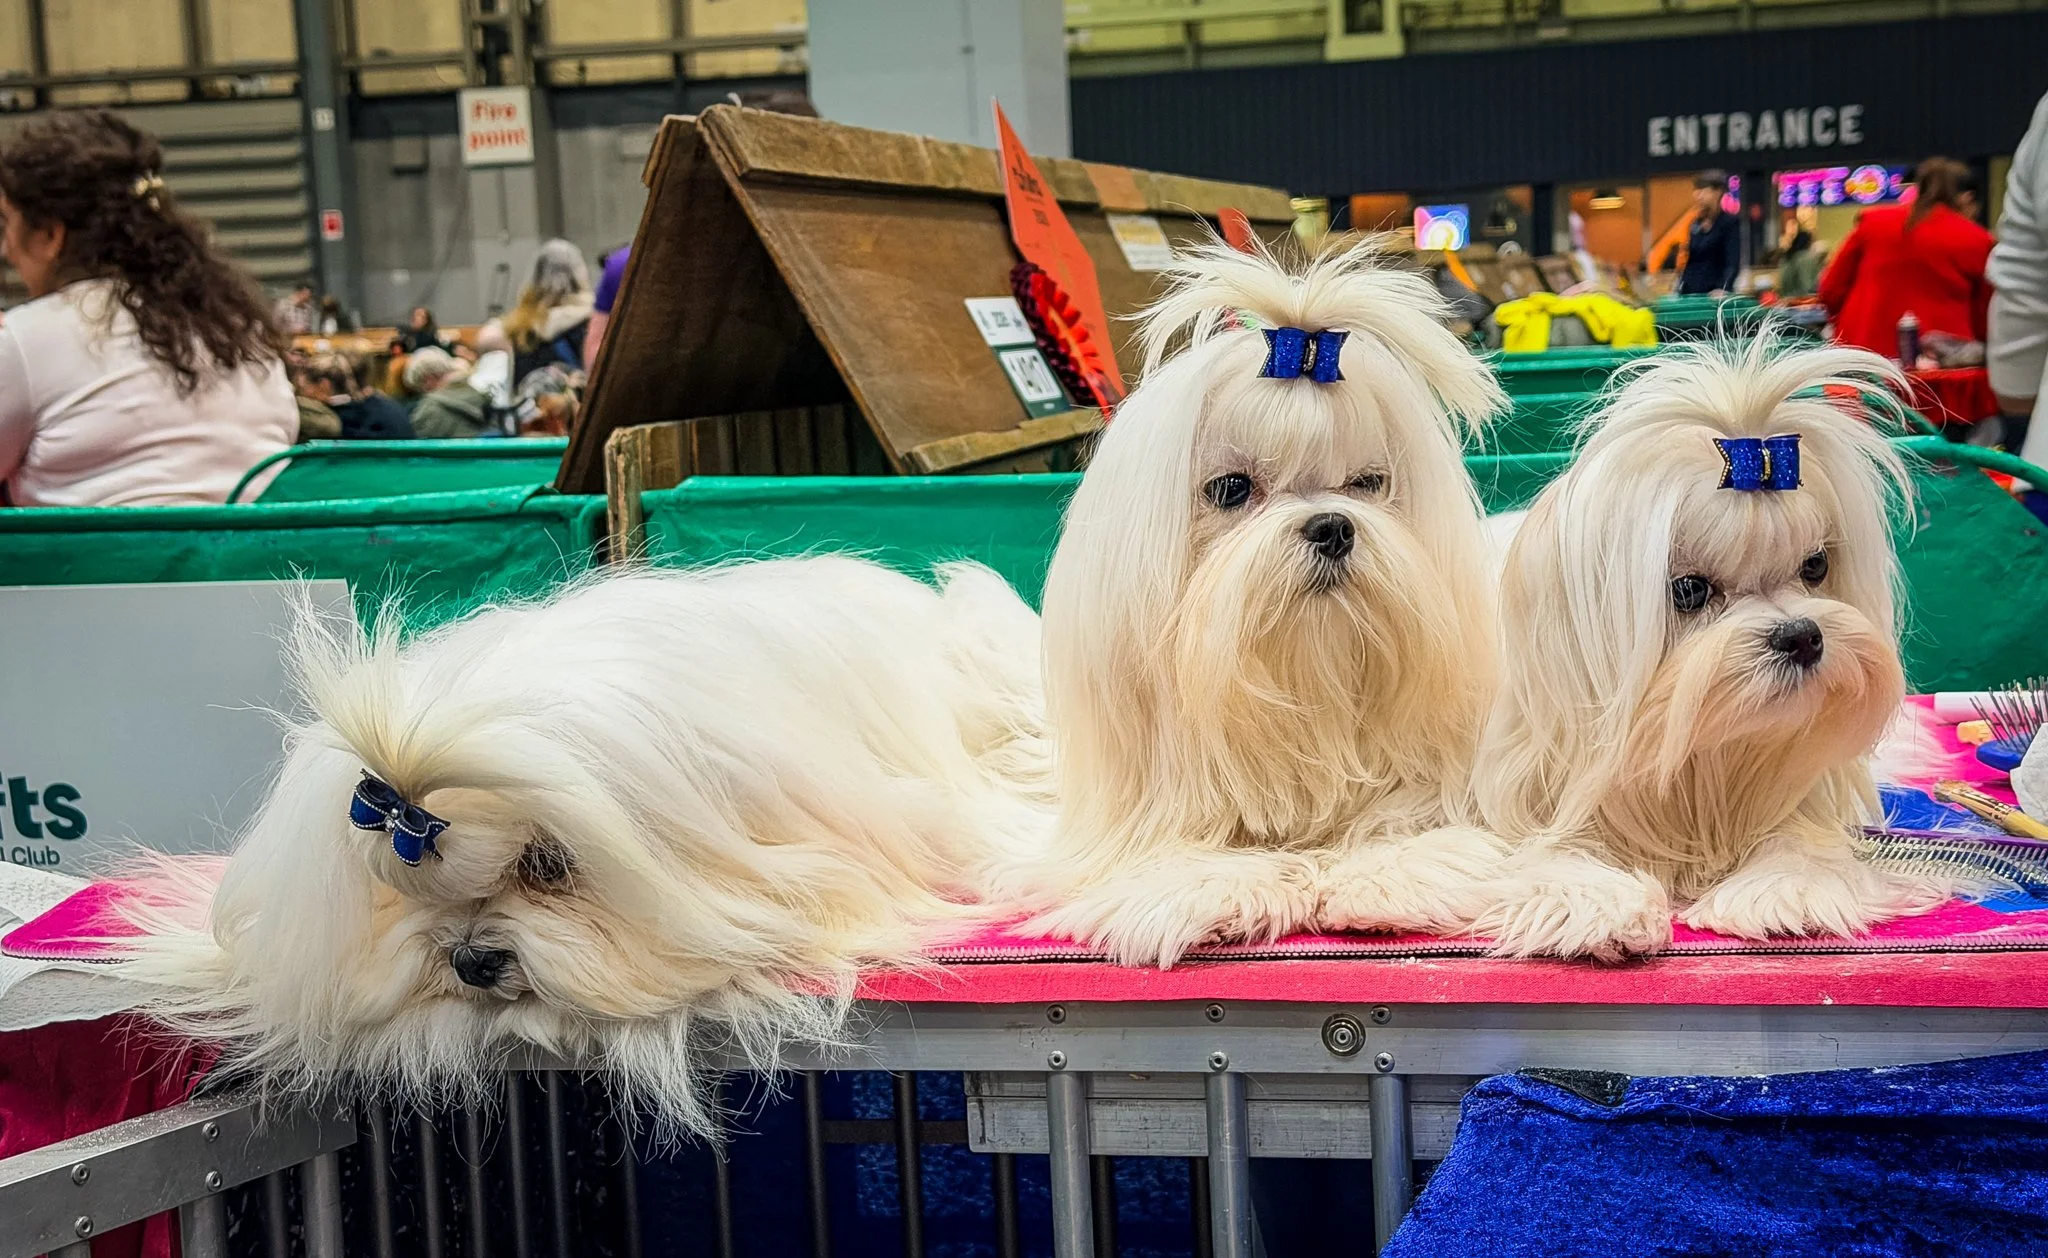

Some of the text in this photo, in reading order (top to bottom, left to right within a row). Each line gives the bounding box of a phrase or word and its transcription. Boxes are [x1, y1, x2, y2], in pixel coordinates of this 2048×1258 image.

[472, 100, 516, 120] Fire
[468, 126, 526, 150] point
[1647, 103, 1864, 157] ENTRANCE
[11, 845, 61, 866] Club
